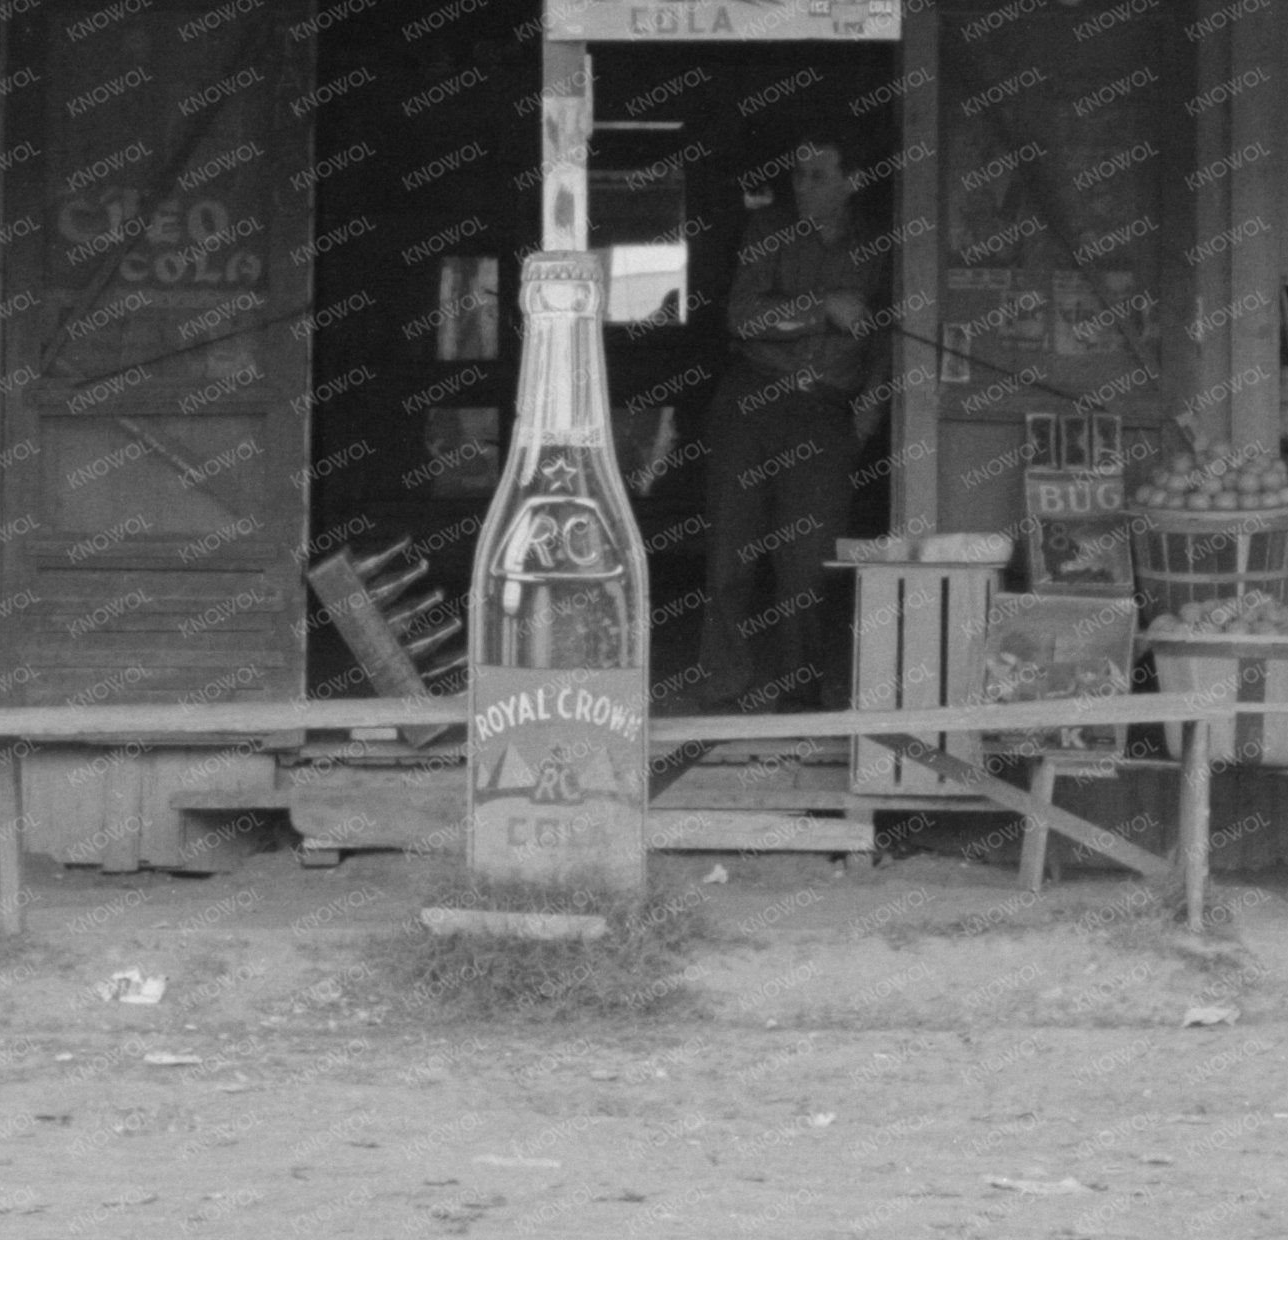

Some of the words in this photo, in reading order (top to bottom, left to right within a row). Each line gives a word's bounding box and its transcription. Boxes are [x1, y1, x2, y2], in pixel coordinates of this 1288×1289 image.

[629, 4, 735, 34] COLA
[527, 516, 600, 567] RC
[474, 688, 552, 742] ROYAL
